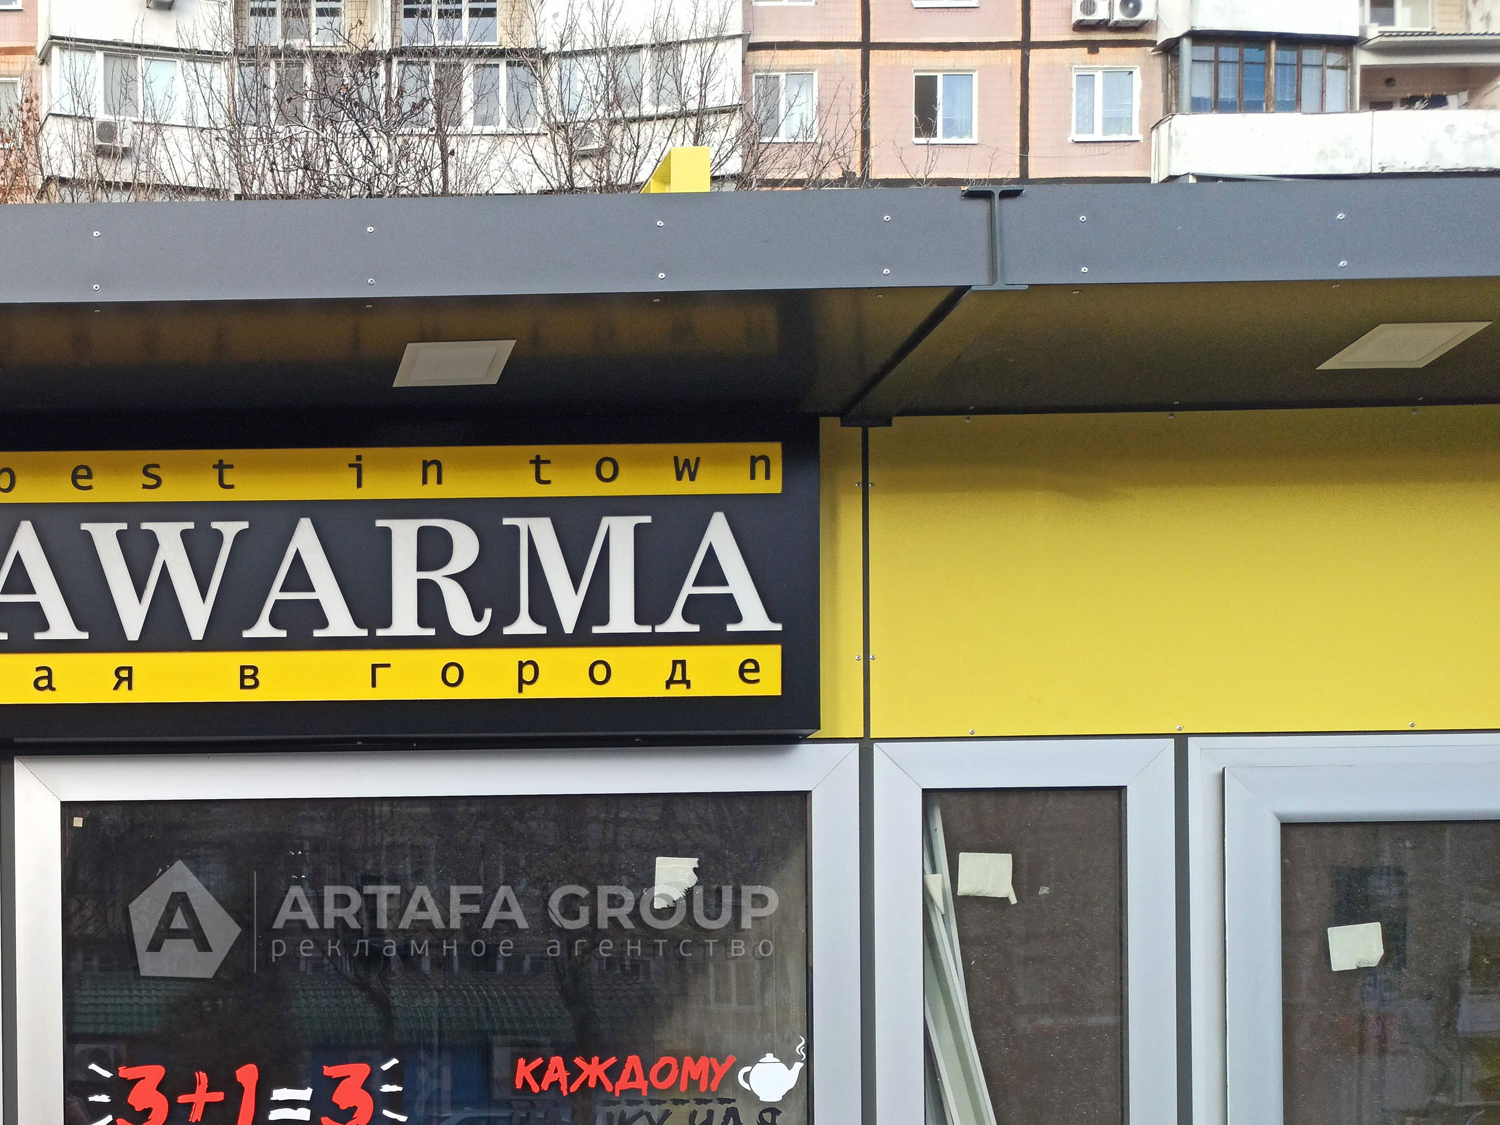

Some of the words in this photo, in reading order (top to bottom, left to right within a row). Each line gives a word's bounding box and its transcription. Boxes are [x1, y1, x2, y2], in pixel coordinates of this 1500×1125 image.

[349, 455, 442, 488] in
[530, 455, 770, 484] town
[240, 666, 259, 689] в
[372, 659, 759, 692] городе
[515, 1055, 736, 1096] КАЖДОМУ
